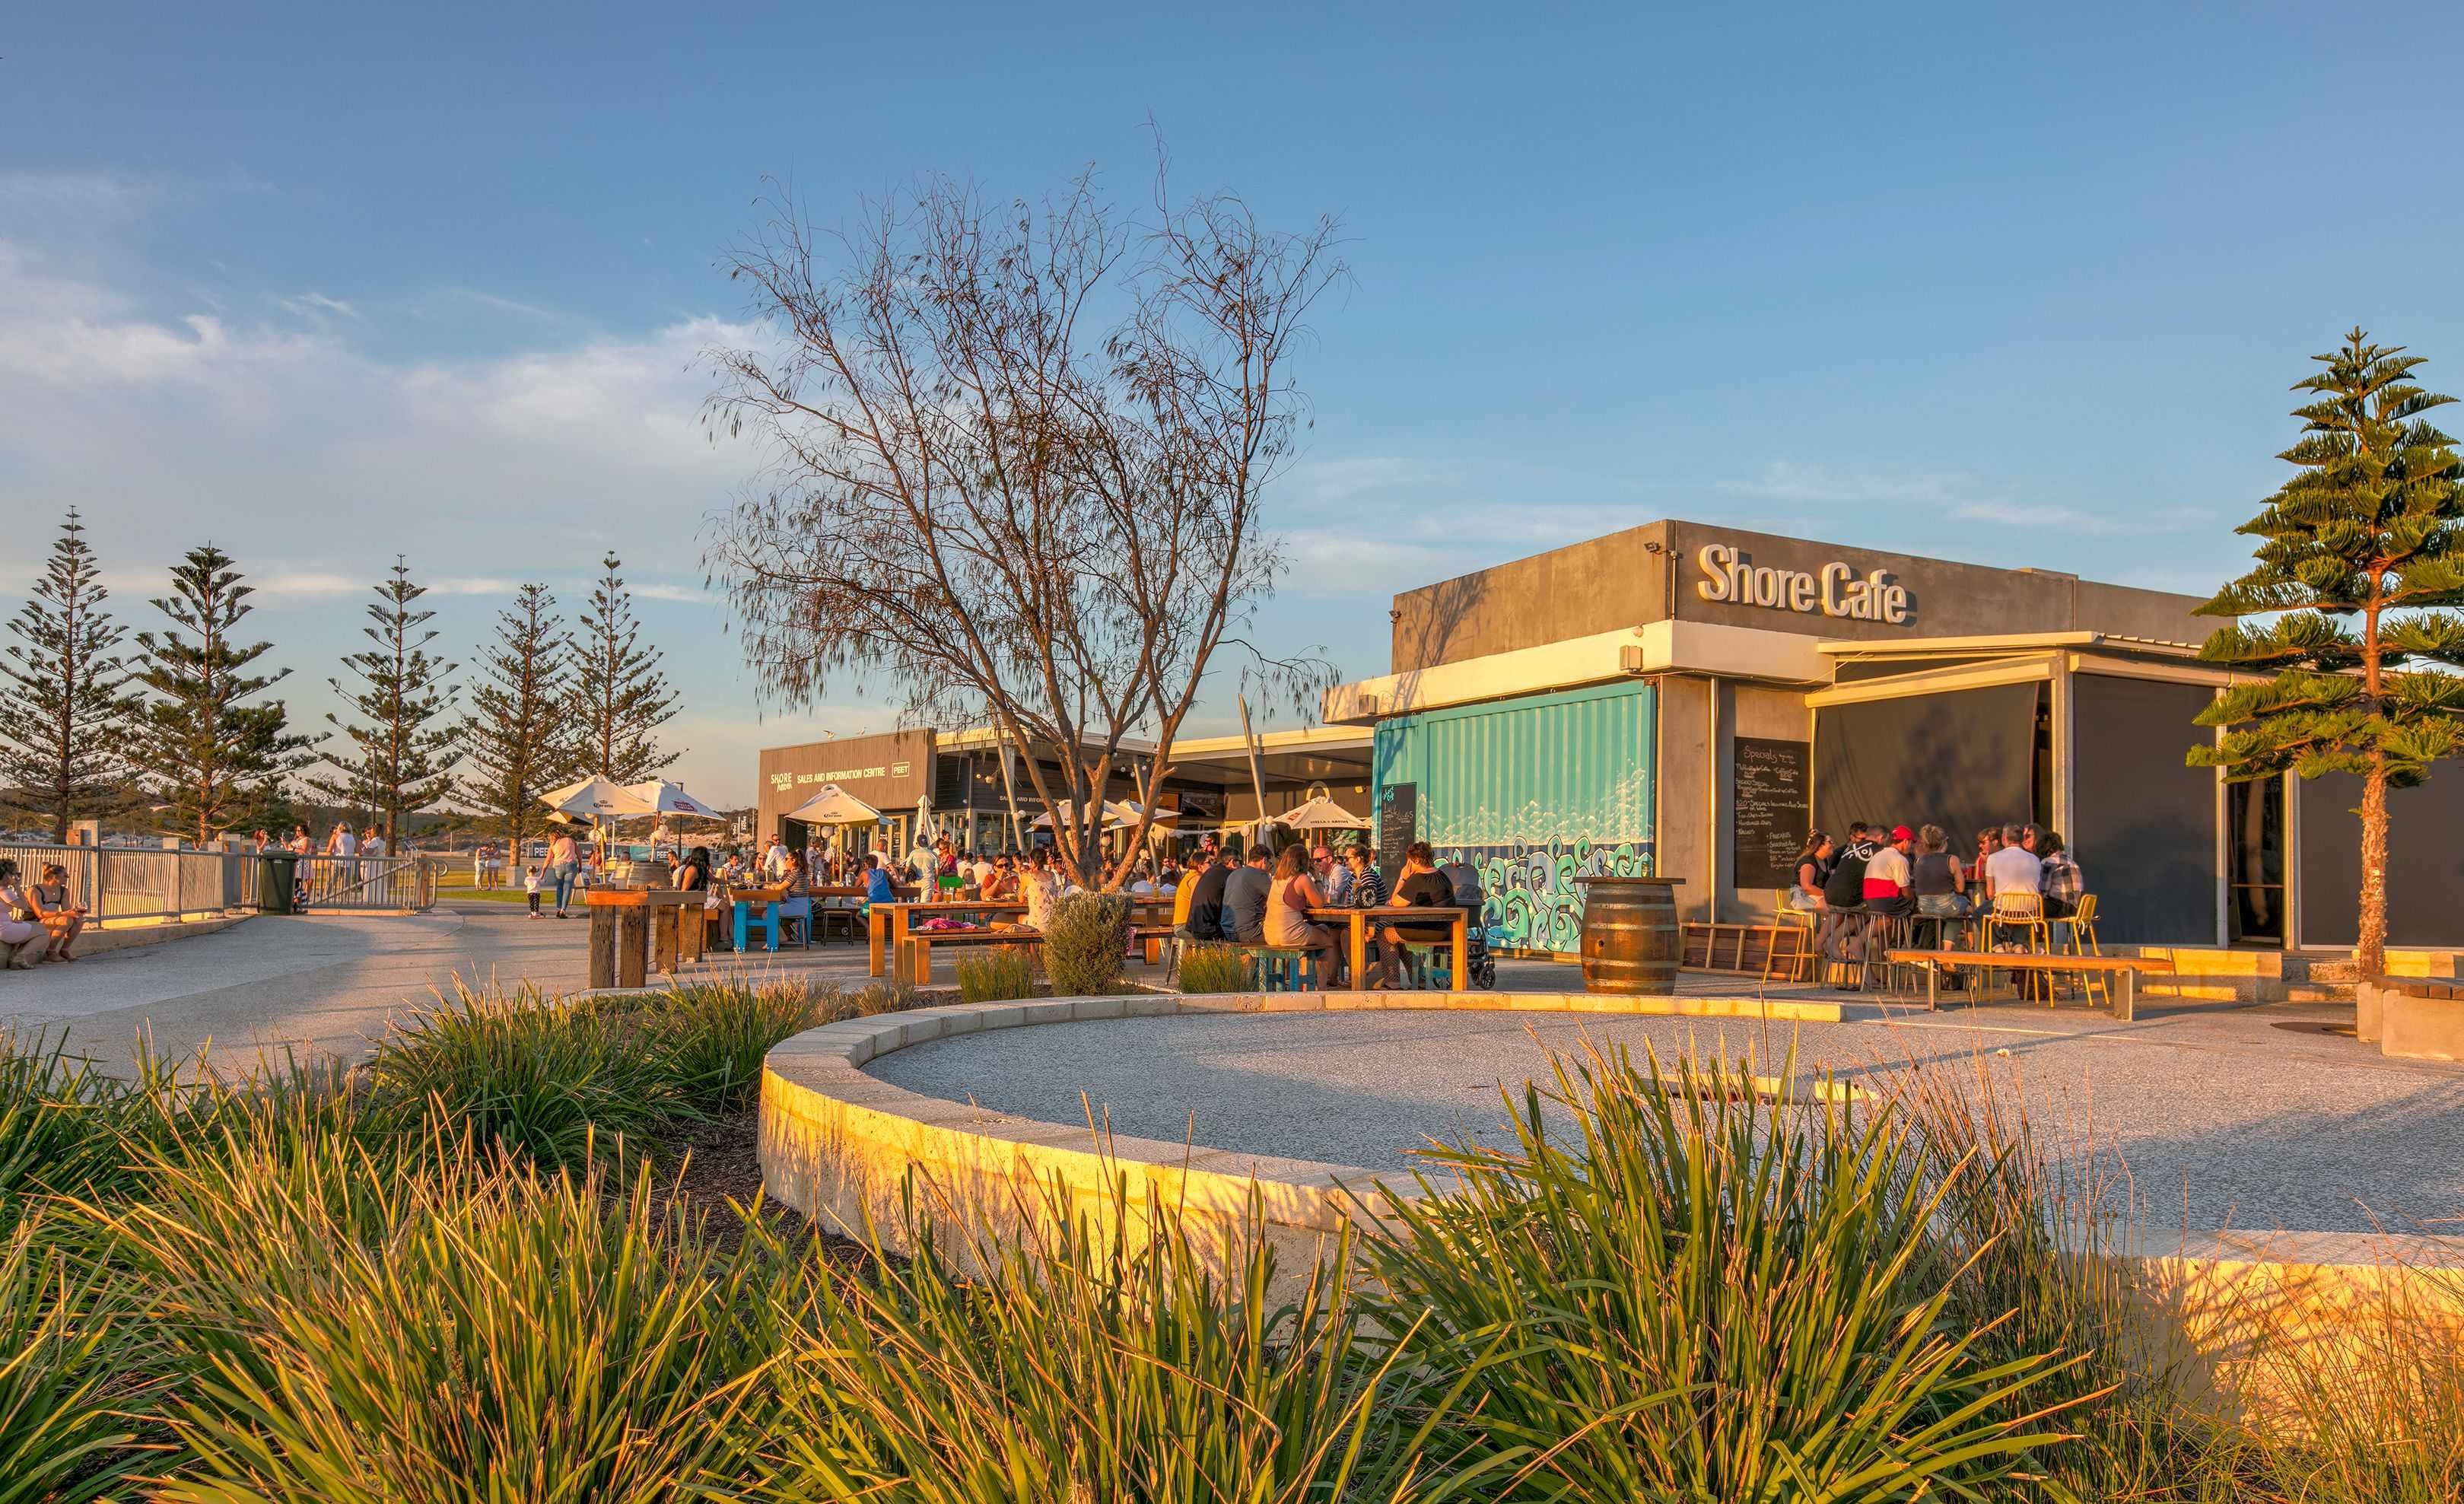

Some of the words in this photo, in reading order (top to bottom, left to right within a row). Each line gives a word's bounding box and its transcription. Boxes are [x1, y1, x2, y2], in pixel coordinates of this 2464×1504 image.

[1698, 544, 1815, 612] Shore
[1820, 561, 1906, 624] Cafe
[796, 773, 813, 784] SALES
[814, 773, 825, 783] AND
[825, 769, 863, 781] INFORMATION
[863, 766, 885, 777] CENTRE
[893, 765, 908, 774] PEET
[771, 772, 792, 784] SHORE
[534, 847, 548, 857] PEE
